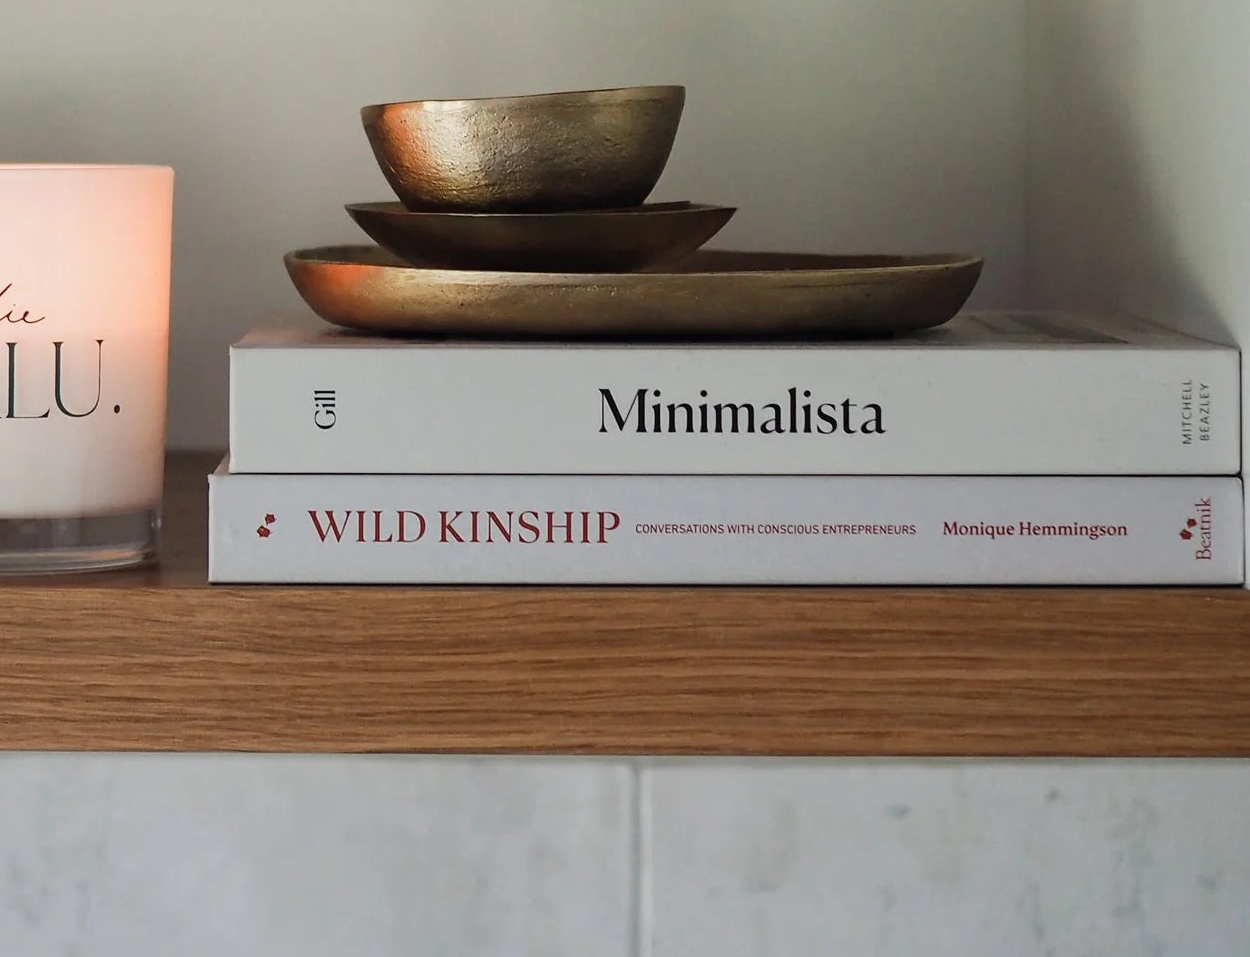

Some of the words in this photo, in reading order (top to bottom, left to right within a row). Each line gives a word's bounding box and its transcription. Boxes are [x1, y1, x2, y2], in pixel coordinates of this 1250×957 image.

[313, 389, 337, 430] Gill
[598, 386, 887, 435] Minimalista
[1181, 379, 1193, 445] MITCHELL
[1199, 382, 1211, 442] BEAZLEY
[308, 509, 427, 543] WILD
[438, 510, 621, 544] KINSHIP
[635, 523, 725, 535] CONVERSATIONS
[727, 523, 755, 535] WITH
[757, 523, 820, 536] CONSCIOUS
[822, 523, 917, 536] ENTREPRENEURS
[942, 520, 1015, 541] Monique
[1018, 521, 1128, 541] Hemmingson
[1195, 497, 1212, 561] Beatnik
